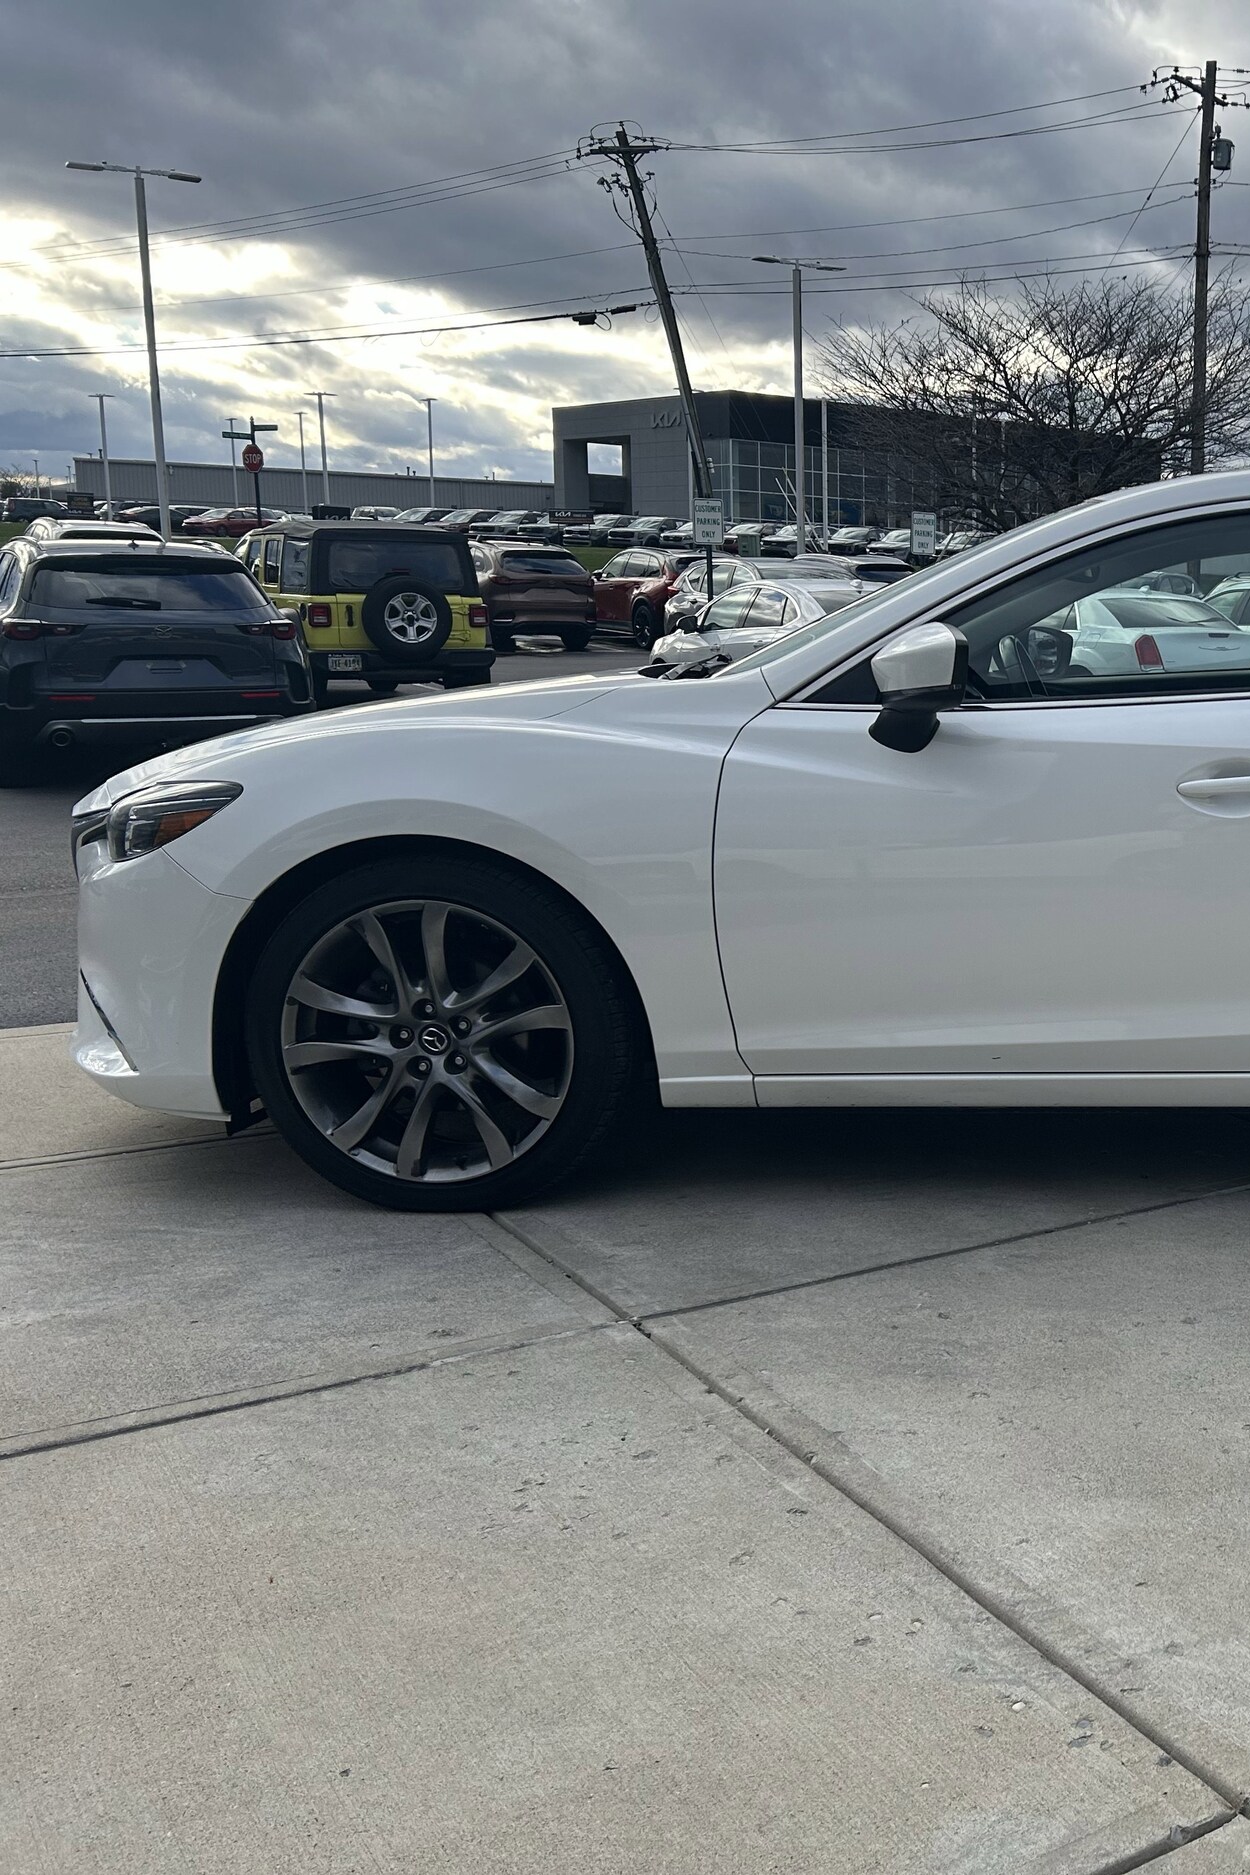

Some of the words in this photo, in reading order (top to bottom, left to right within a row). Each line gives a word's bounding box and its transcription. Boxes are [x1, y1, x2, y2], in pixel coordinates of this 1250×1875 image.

[652, 411, 682, 429] KIA
[245, 454, 261, 464] STOP
[695, 505, 721, 513] CUSTOMER
[696, 518, 720, 526] PARKING
[913, 518, 934, 526] CUSTOMER
[702, 530, 716, 538] ONLY
[915, 530, 933, 538] PARKING
